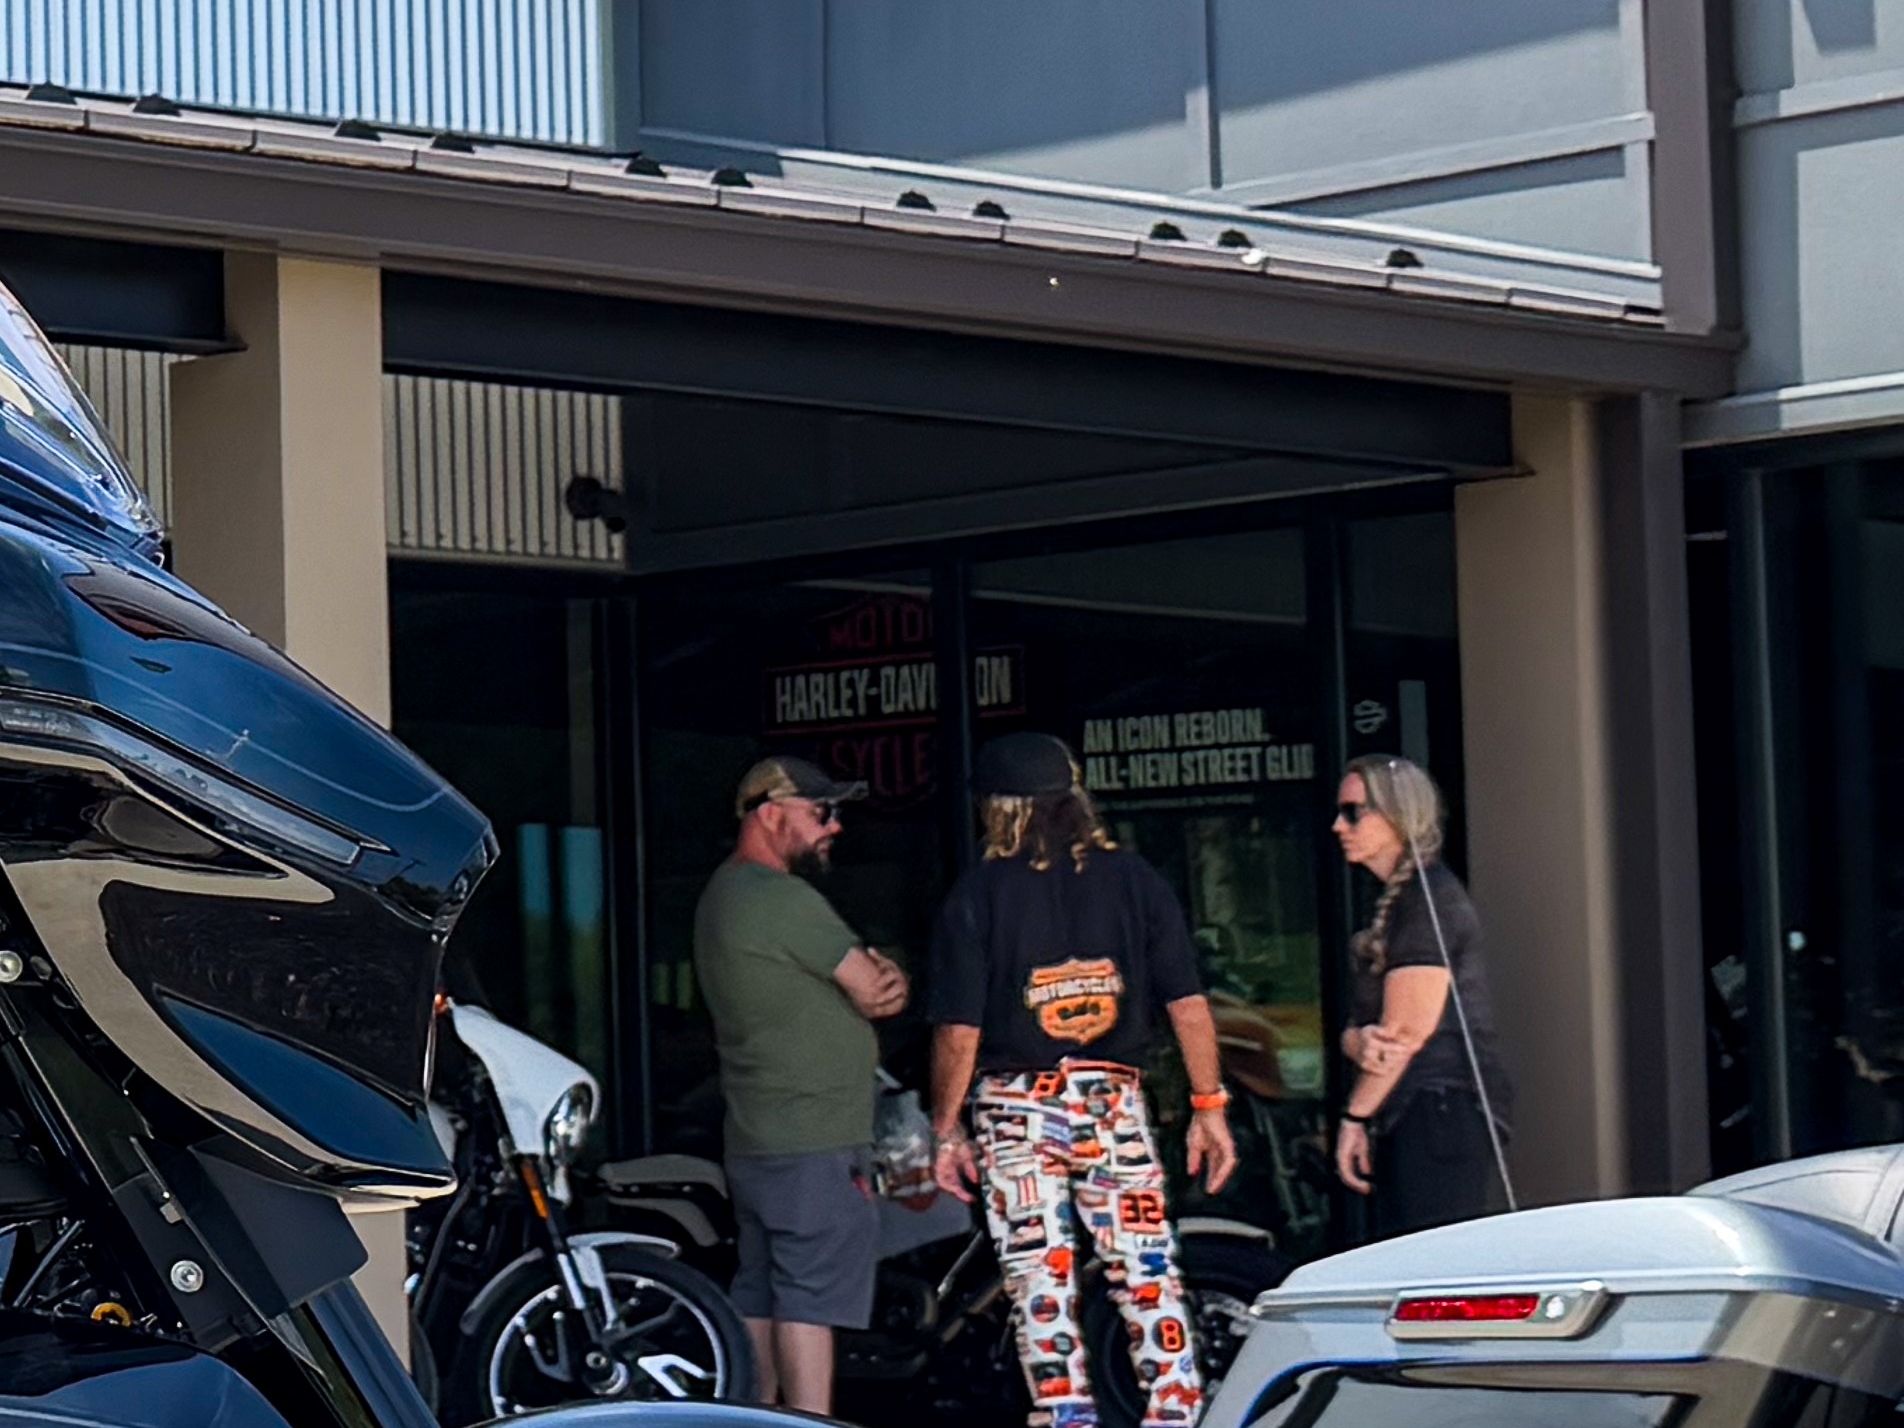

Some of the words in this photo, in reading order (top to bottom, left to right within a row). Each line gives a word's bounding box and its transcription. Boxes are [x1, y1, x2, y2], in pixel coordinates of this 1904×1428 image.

[829, 598, 934, 652] MOTO
[774, 655, 1013, 724] HARLEY-DAVION
[1083, 718, 1114, 754] AN
[1116, 714, 1170, 753] ICON
[831, 732, 934, 797] CYCLE
[1085, 752, 1179, 790] ALL-NEW
[1180, 746, 1263, 787] STREET
[1265, 742, 1314, 781] GLID
